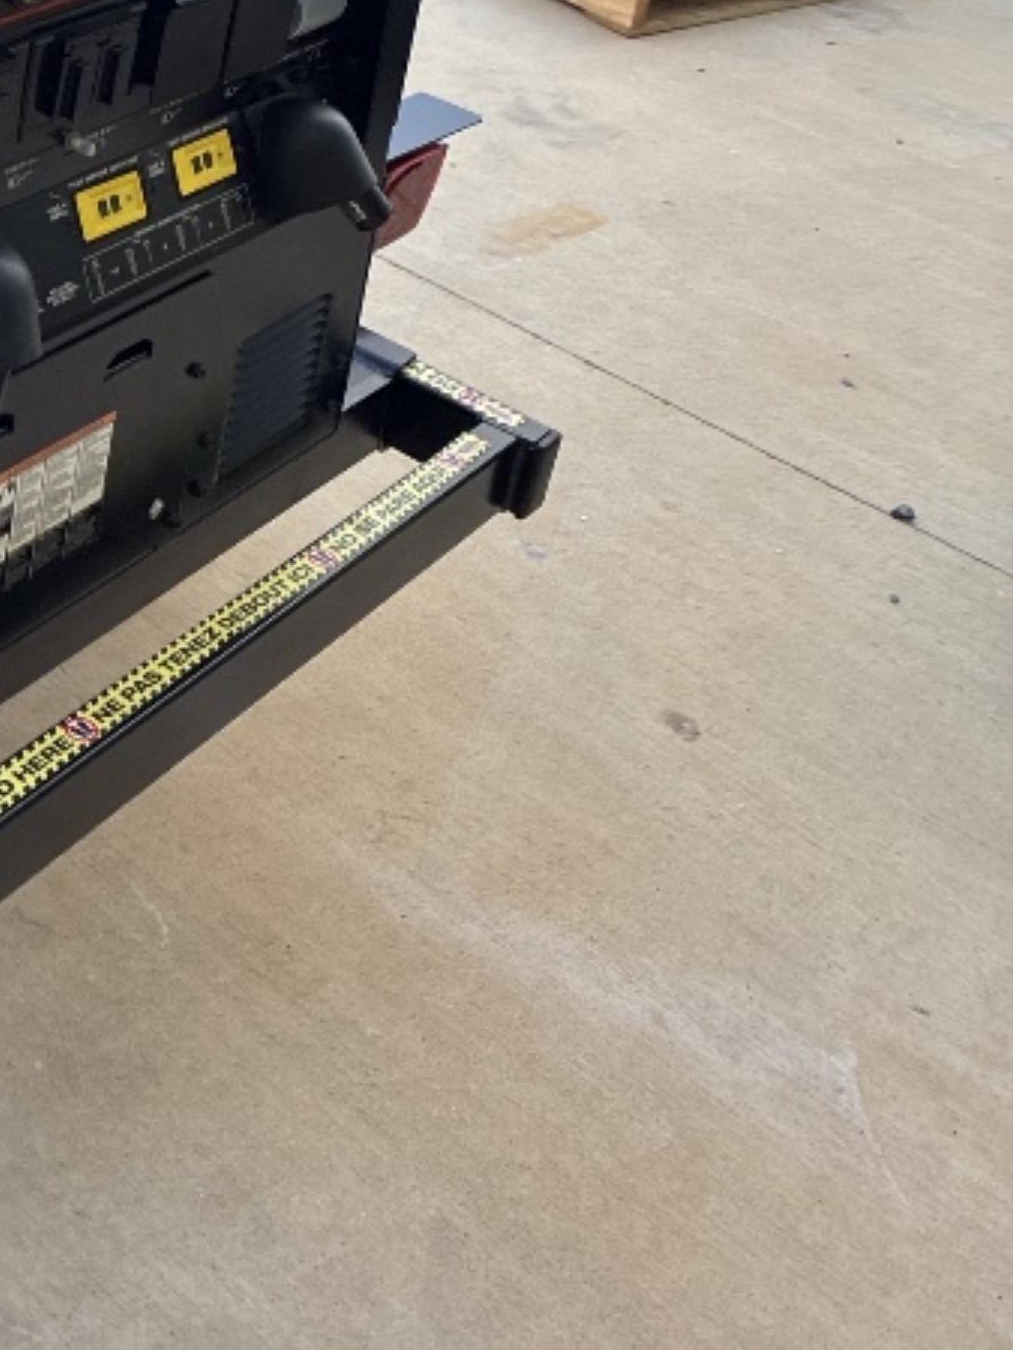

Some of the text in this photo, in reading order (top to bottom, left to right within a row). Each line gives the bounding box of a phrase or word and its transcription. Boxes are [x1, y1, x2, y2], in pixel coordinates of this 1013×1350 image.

[94, 696, 123, 722] NE
[123, 669, 162, 705] PAS
[159, 628, 221, 676] TENEZ
[217, 576, 290, 632] DEBOUT
[13, 738, 74, 781] HERE
